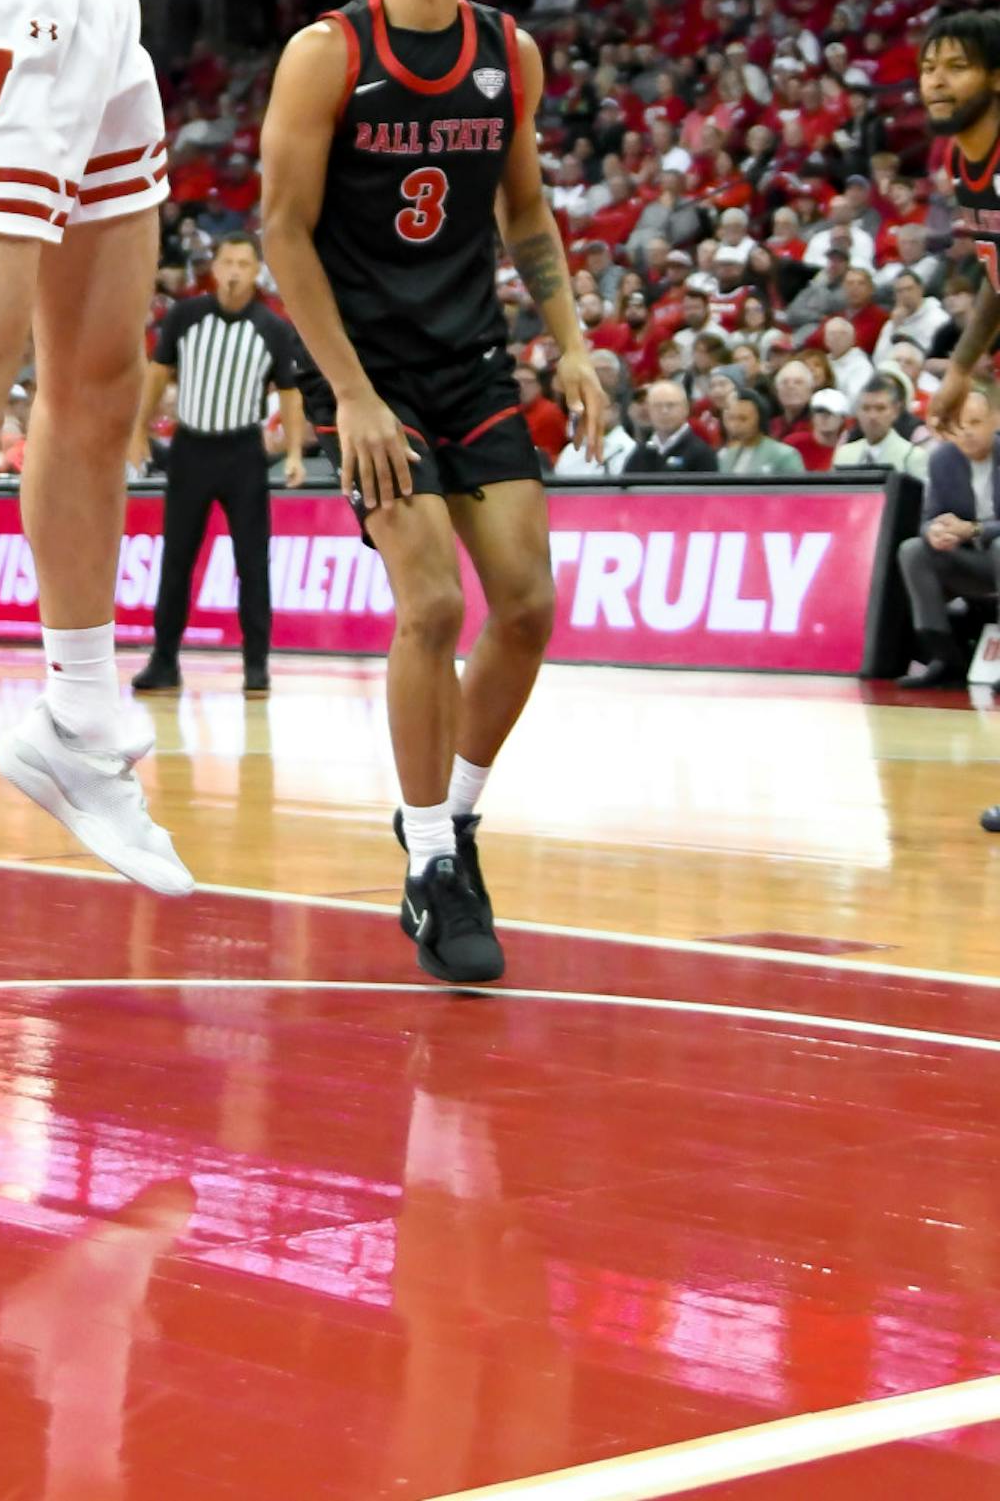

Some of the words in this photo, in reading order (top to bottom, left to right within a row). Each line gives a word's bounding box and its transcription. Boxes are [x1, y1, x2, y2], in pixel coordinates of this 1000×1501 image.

[355, 121, 424, 155] BALL
[429, 118, 504, 152] STATE
[395, 166, 449, 243] 3
[197, 535, 396, 614] AHLETIC
[549, 531, 832, 634] TRULY
